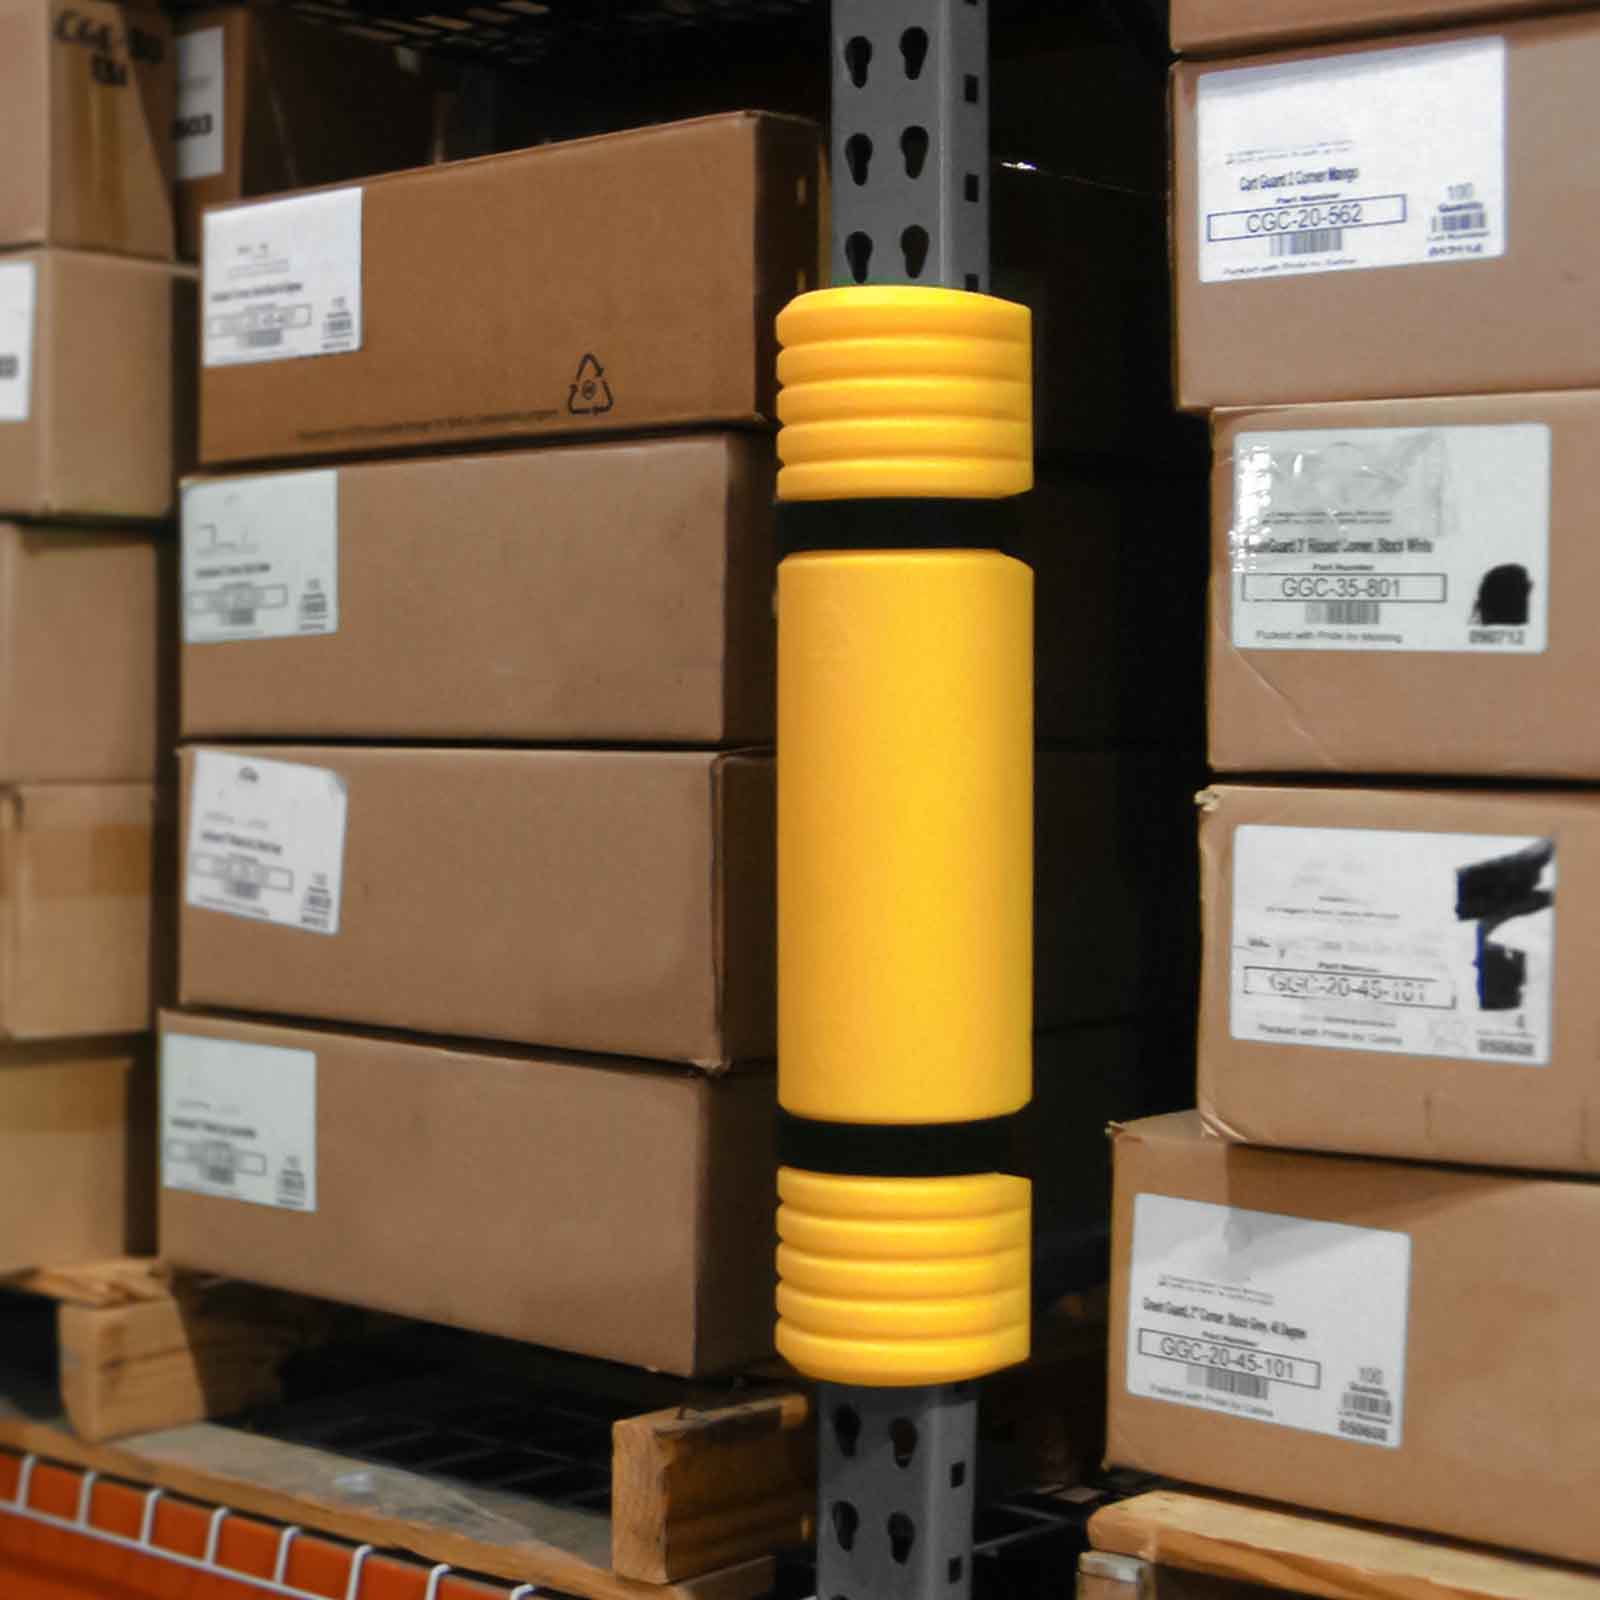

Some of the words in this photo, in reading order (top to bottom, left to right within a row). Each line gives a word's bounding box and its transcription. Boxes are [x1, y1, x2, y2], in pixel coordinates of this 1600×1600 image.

[1296, 169, 1328, 185] Corner
[1328, 167, 1359, 184] Mango
[1247, 203, 1363, 233] CGC-20-562
[1281, 576, 1400, 598] GGC-35-801
[1160, 1337, 1294, 1379] GGC-20-45-101
